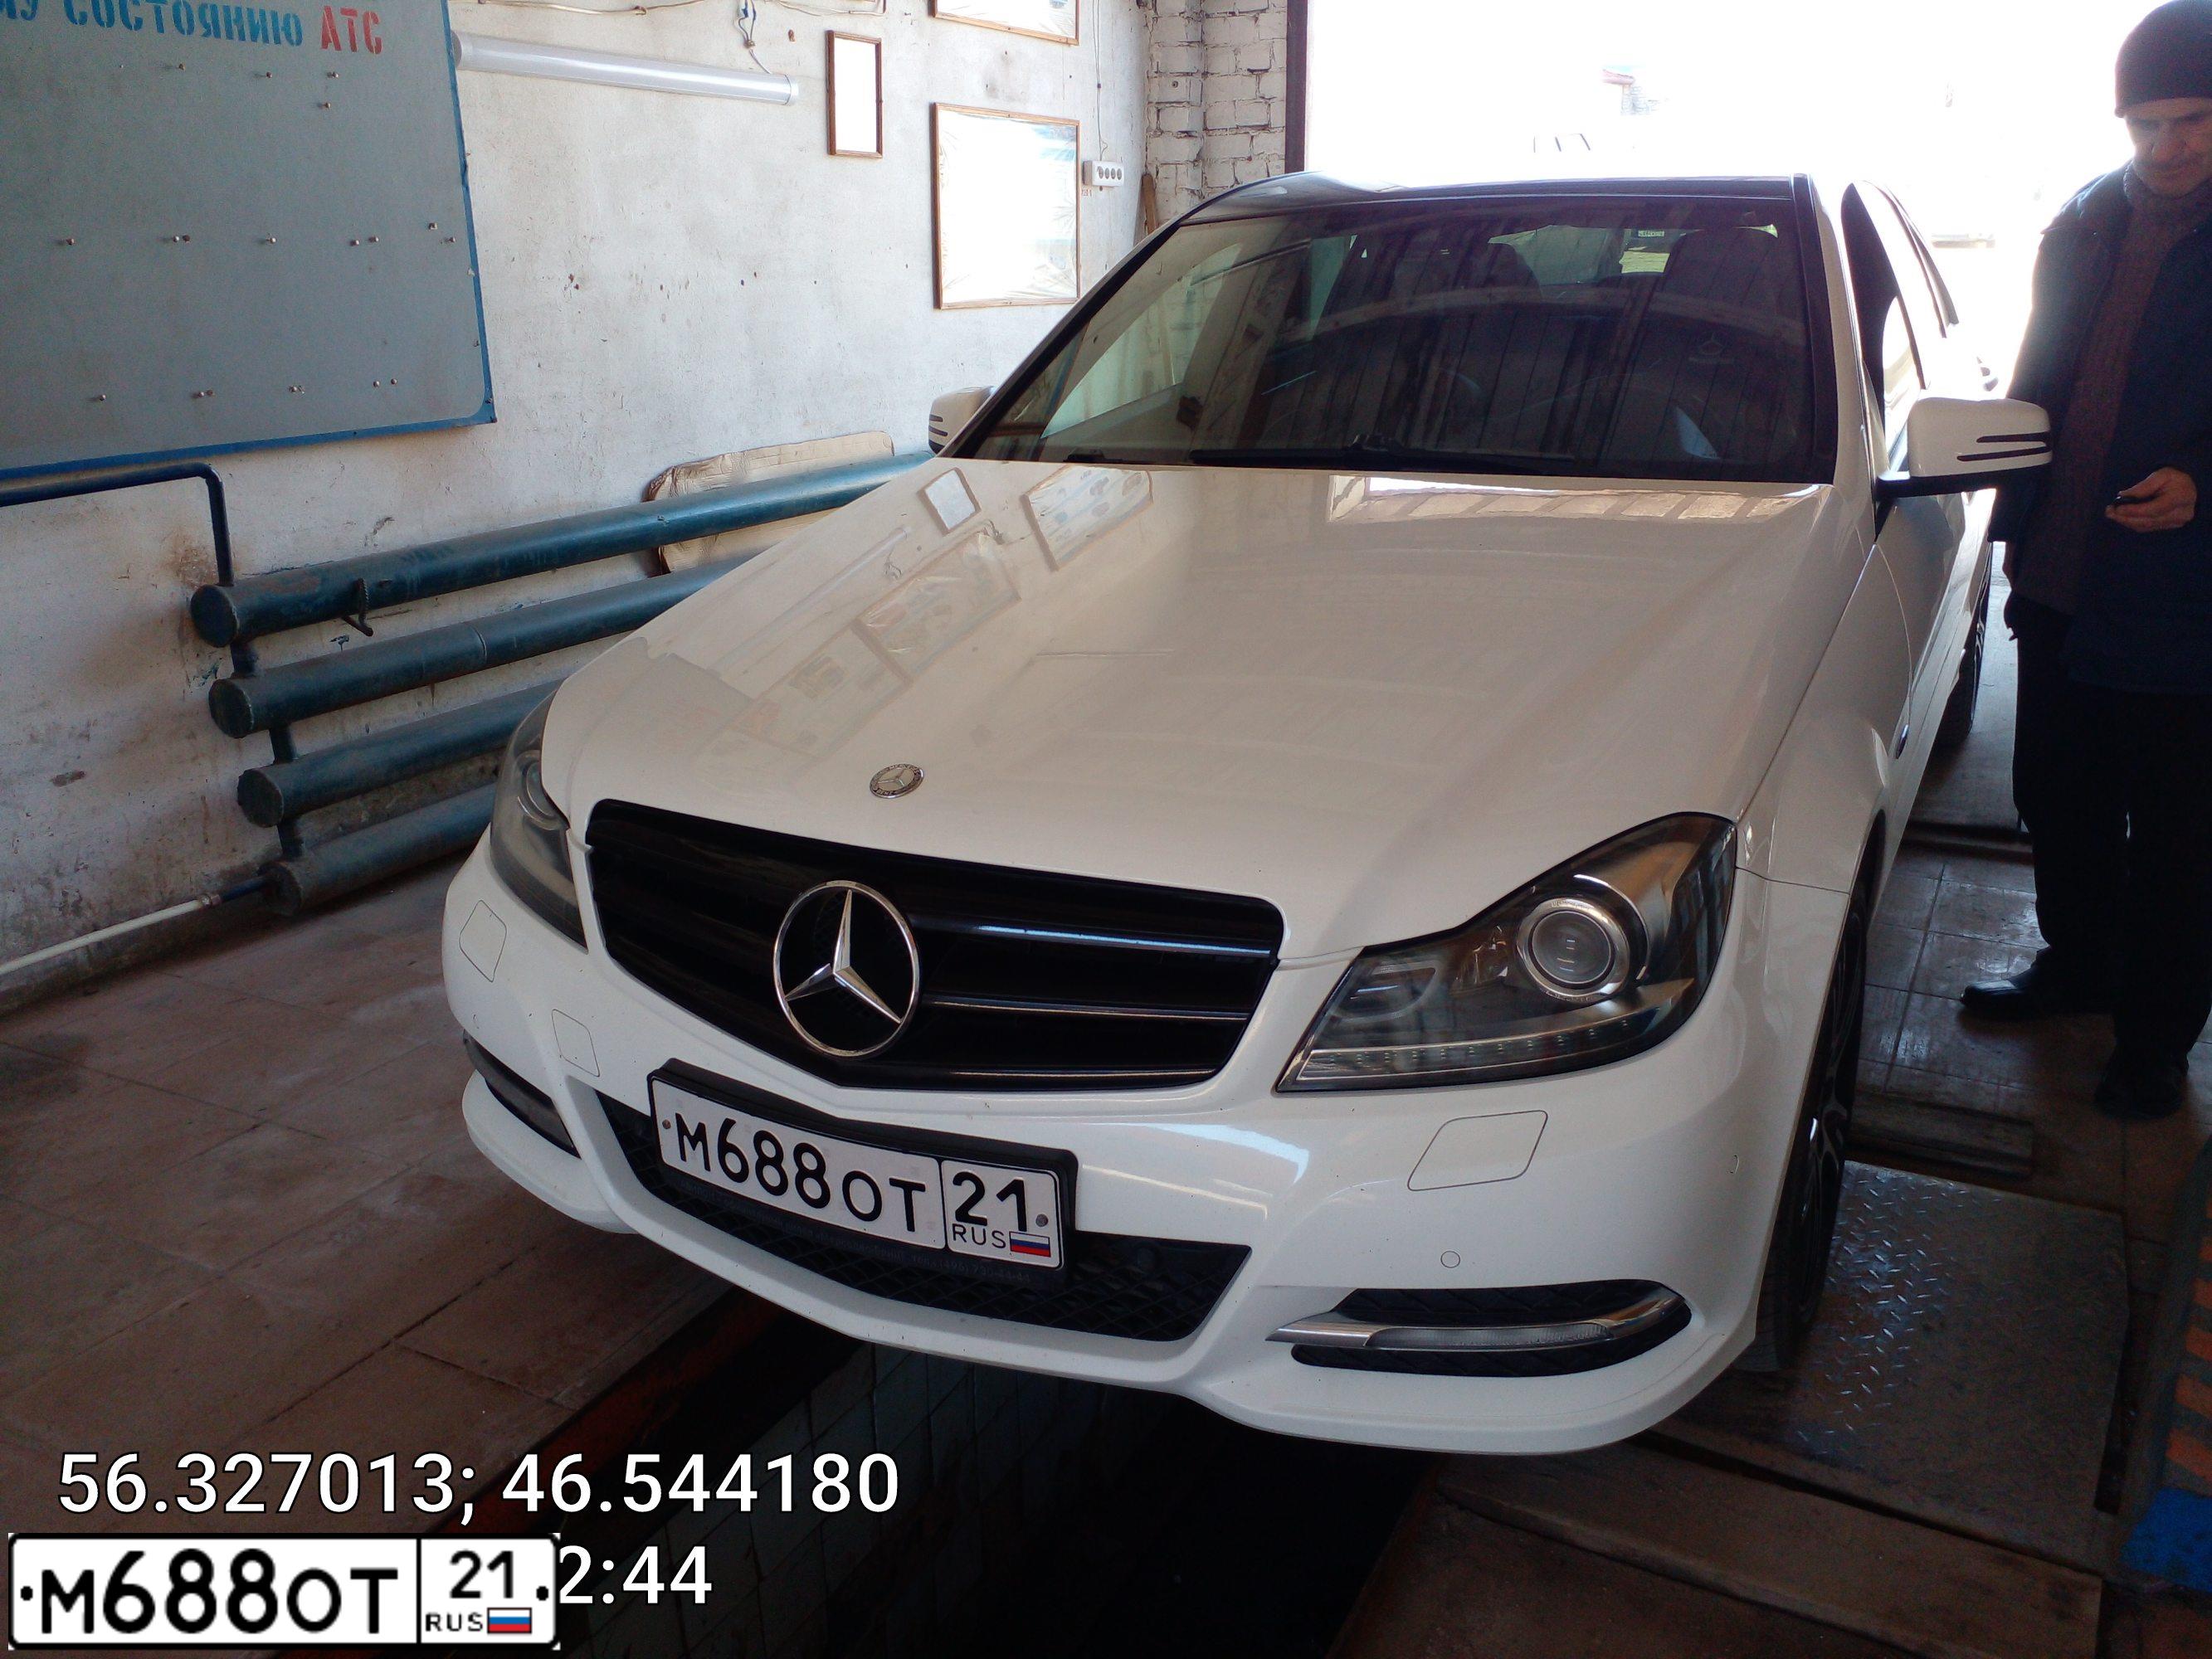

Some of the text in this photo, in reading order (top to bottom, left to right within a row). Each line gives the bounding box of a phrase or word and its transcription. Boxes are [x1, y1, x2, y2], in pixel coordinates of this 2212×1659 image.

[63, 0, 304, 46] СОСТОЯНИЮ
[320, 5, 383, 55] АТС
[952, 1171, 1028, 1233] 21
[953, 1223, 1006, 1249] RUS
